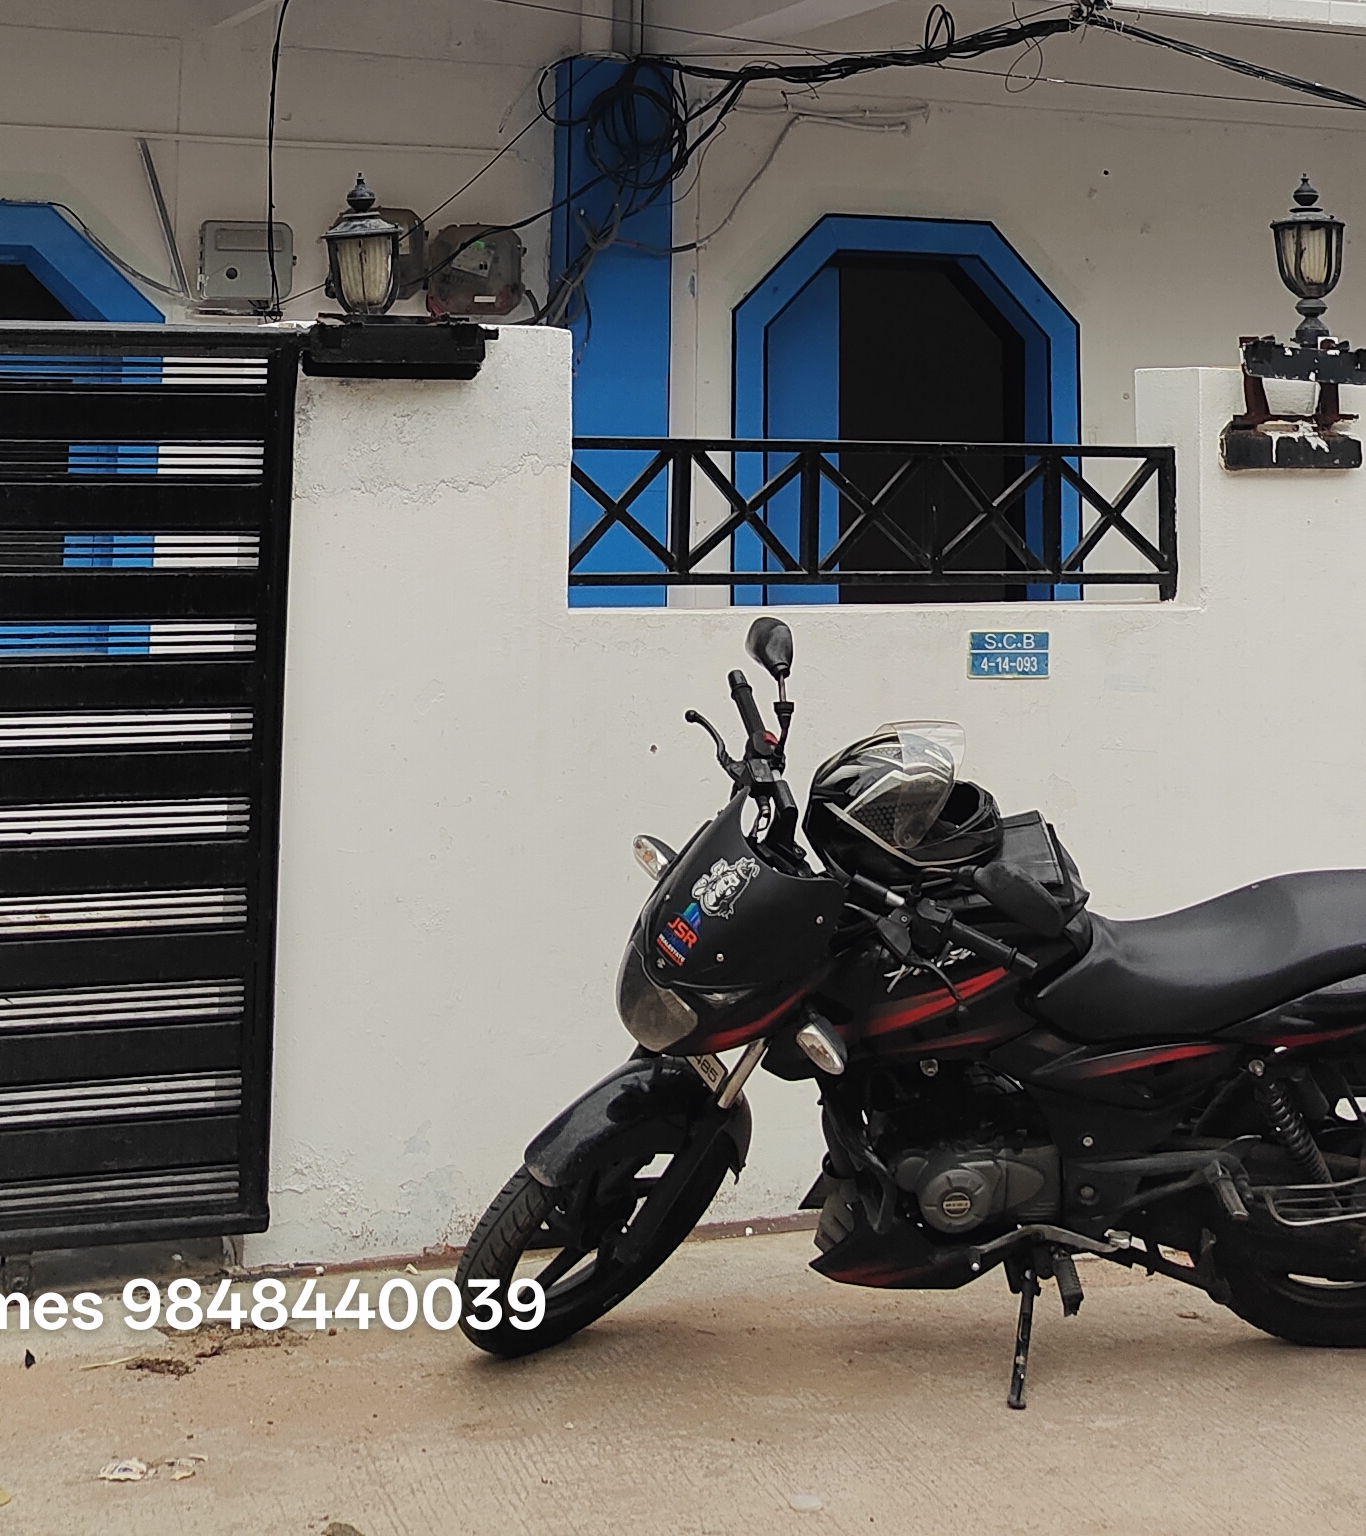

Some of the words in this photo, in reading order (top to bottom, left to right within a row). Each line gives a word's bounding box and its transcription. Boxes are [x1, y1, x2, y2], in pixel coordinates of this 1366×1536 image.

[984, 633, 1036, 649] S.C.B
[980, 656, 1038, 672] 4-14-093
[667, 916, 698, 949] JSR
